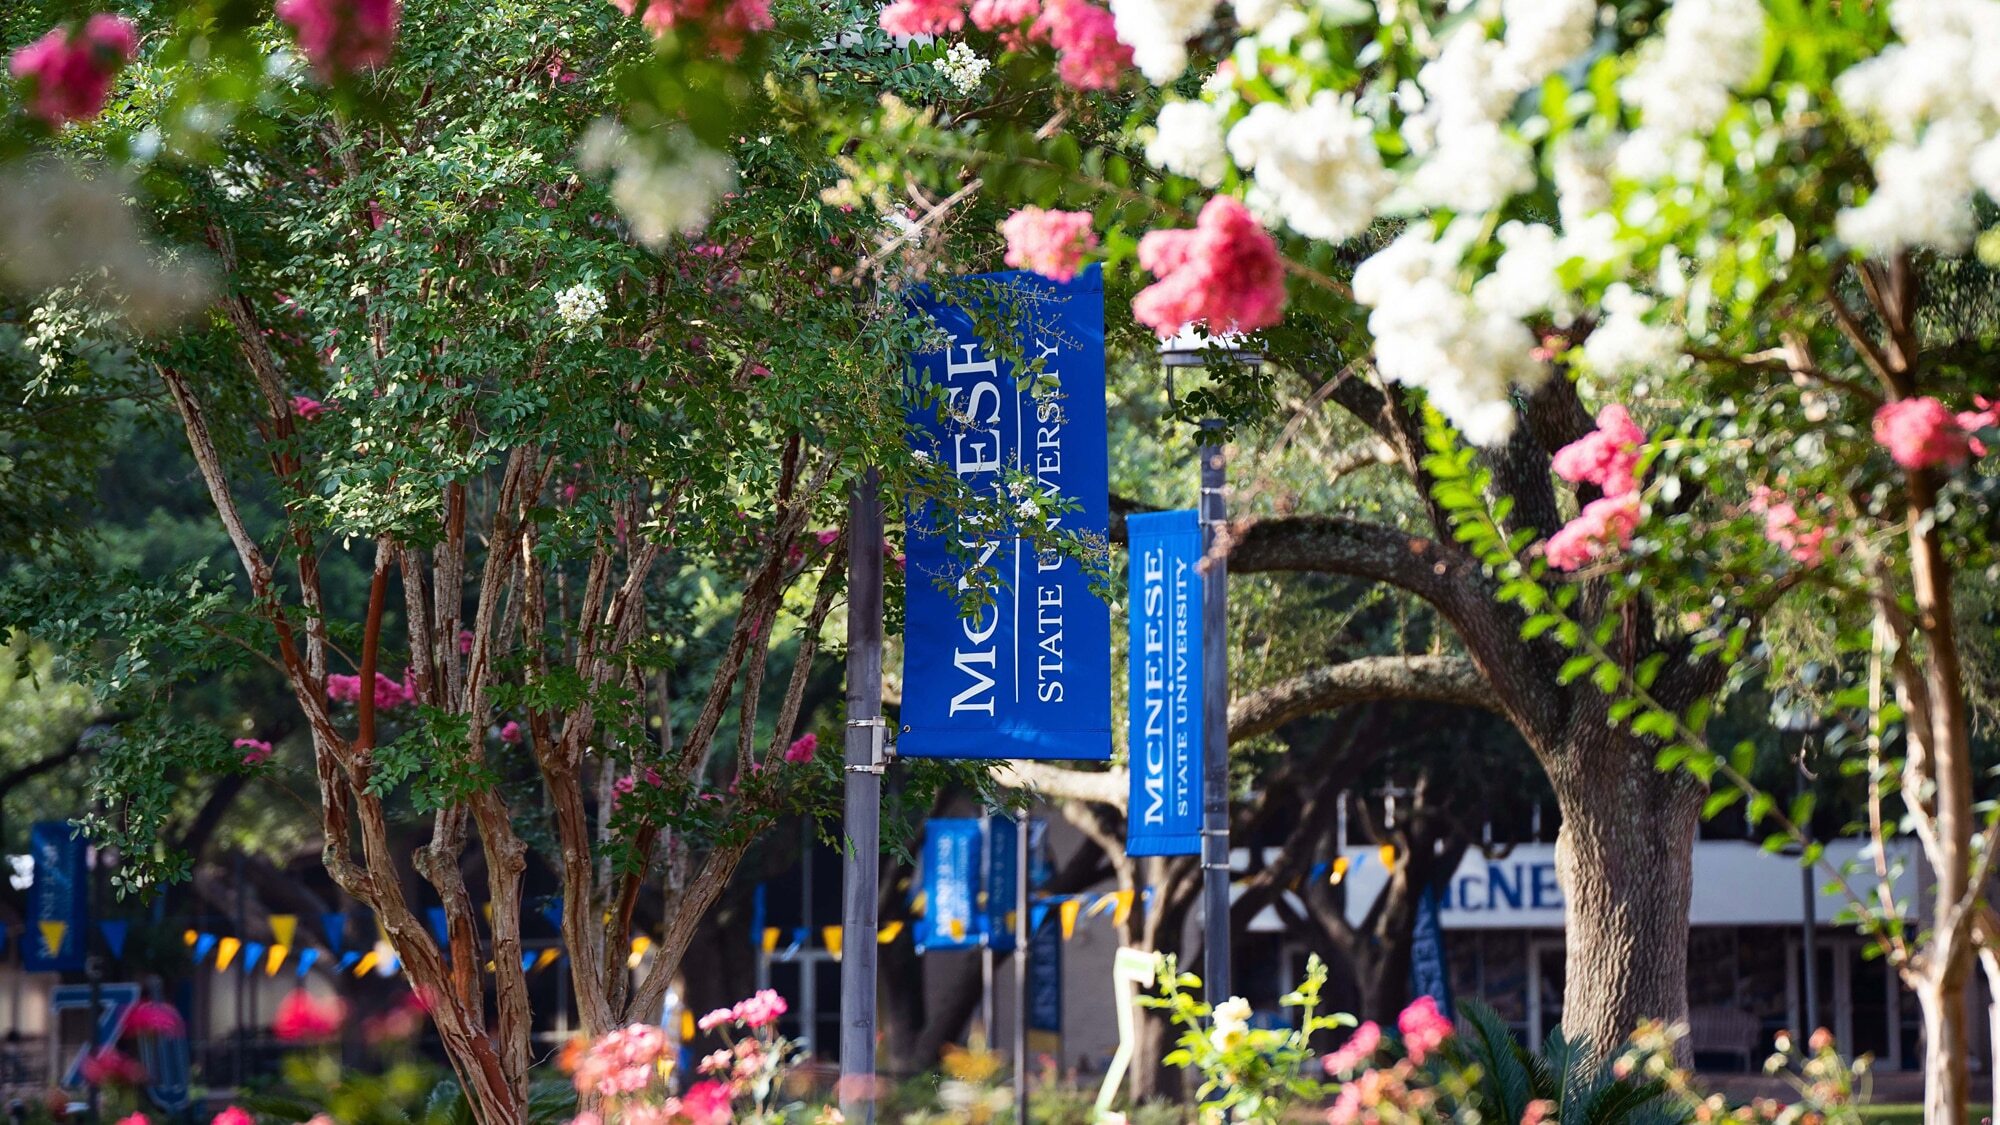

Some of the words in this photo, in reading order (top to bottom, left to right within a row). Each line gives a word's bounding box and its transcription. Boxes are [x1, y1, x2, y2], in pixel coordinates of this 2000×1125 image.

[1037, 584, 1064, 702] STATE
[1175, 557, 1188, 725] UNIVERSITY
[1176, 731, 1188, 817] STATE
